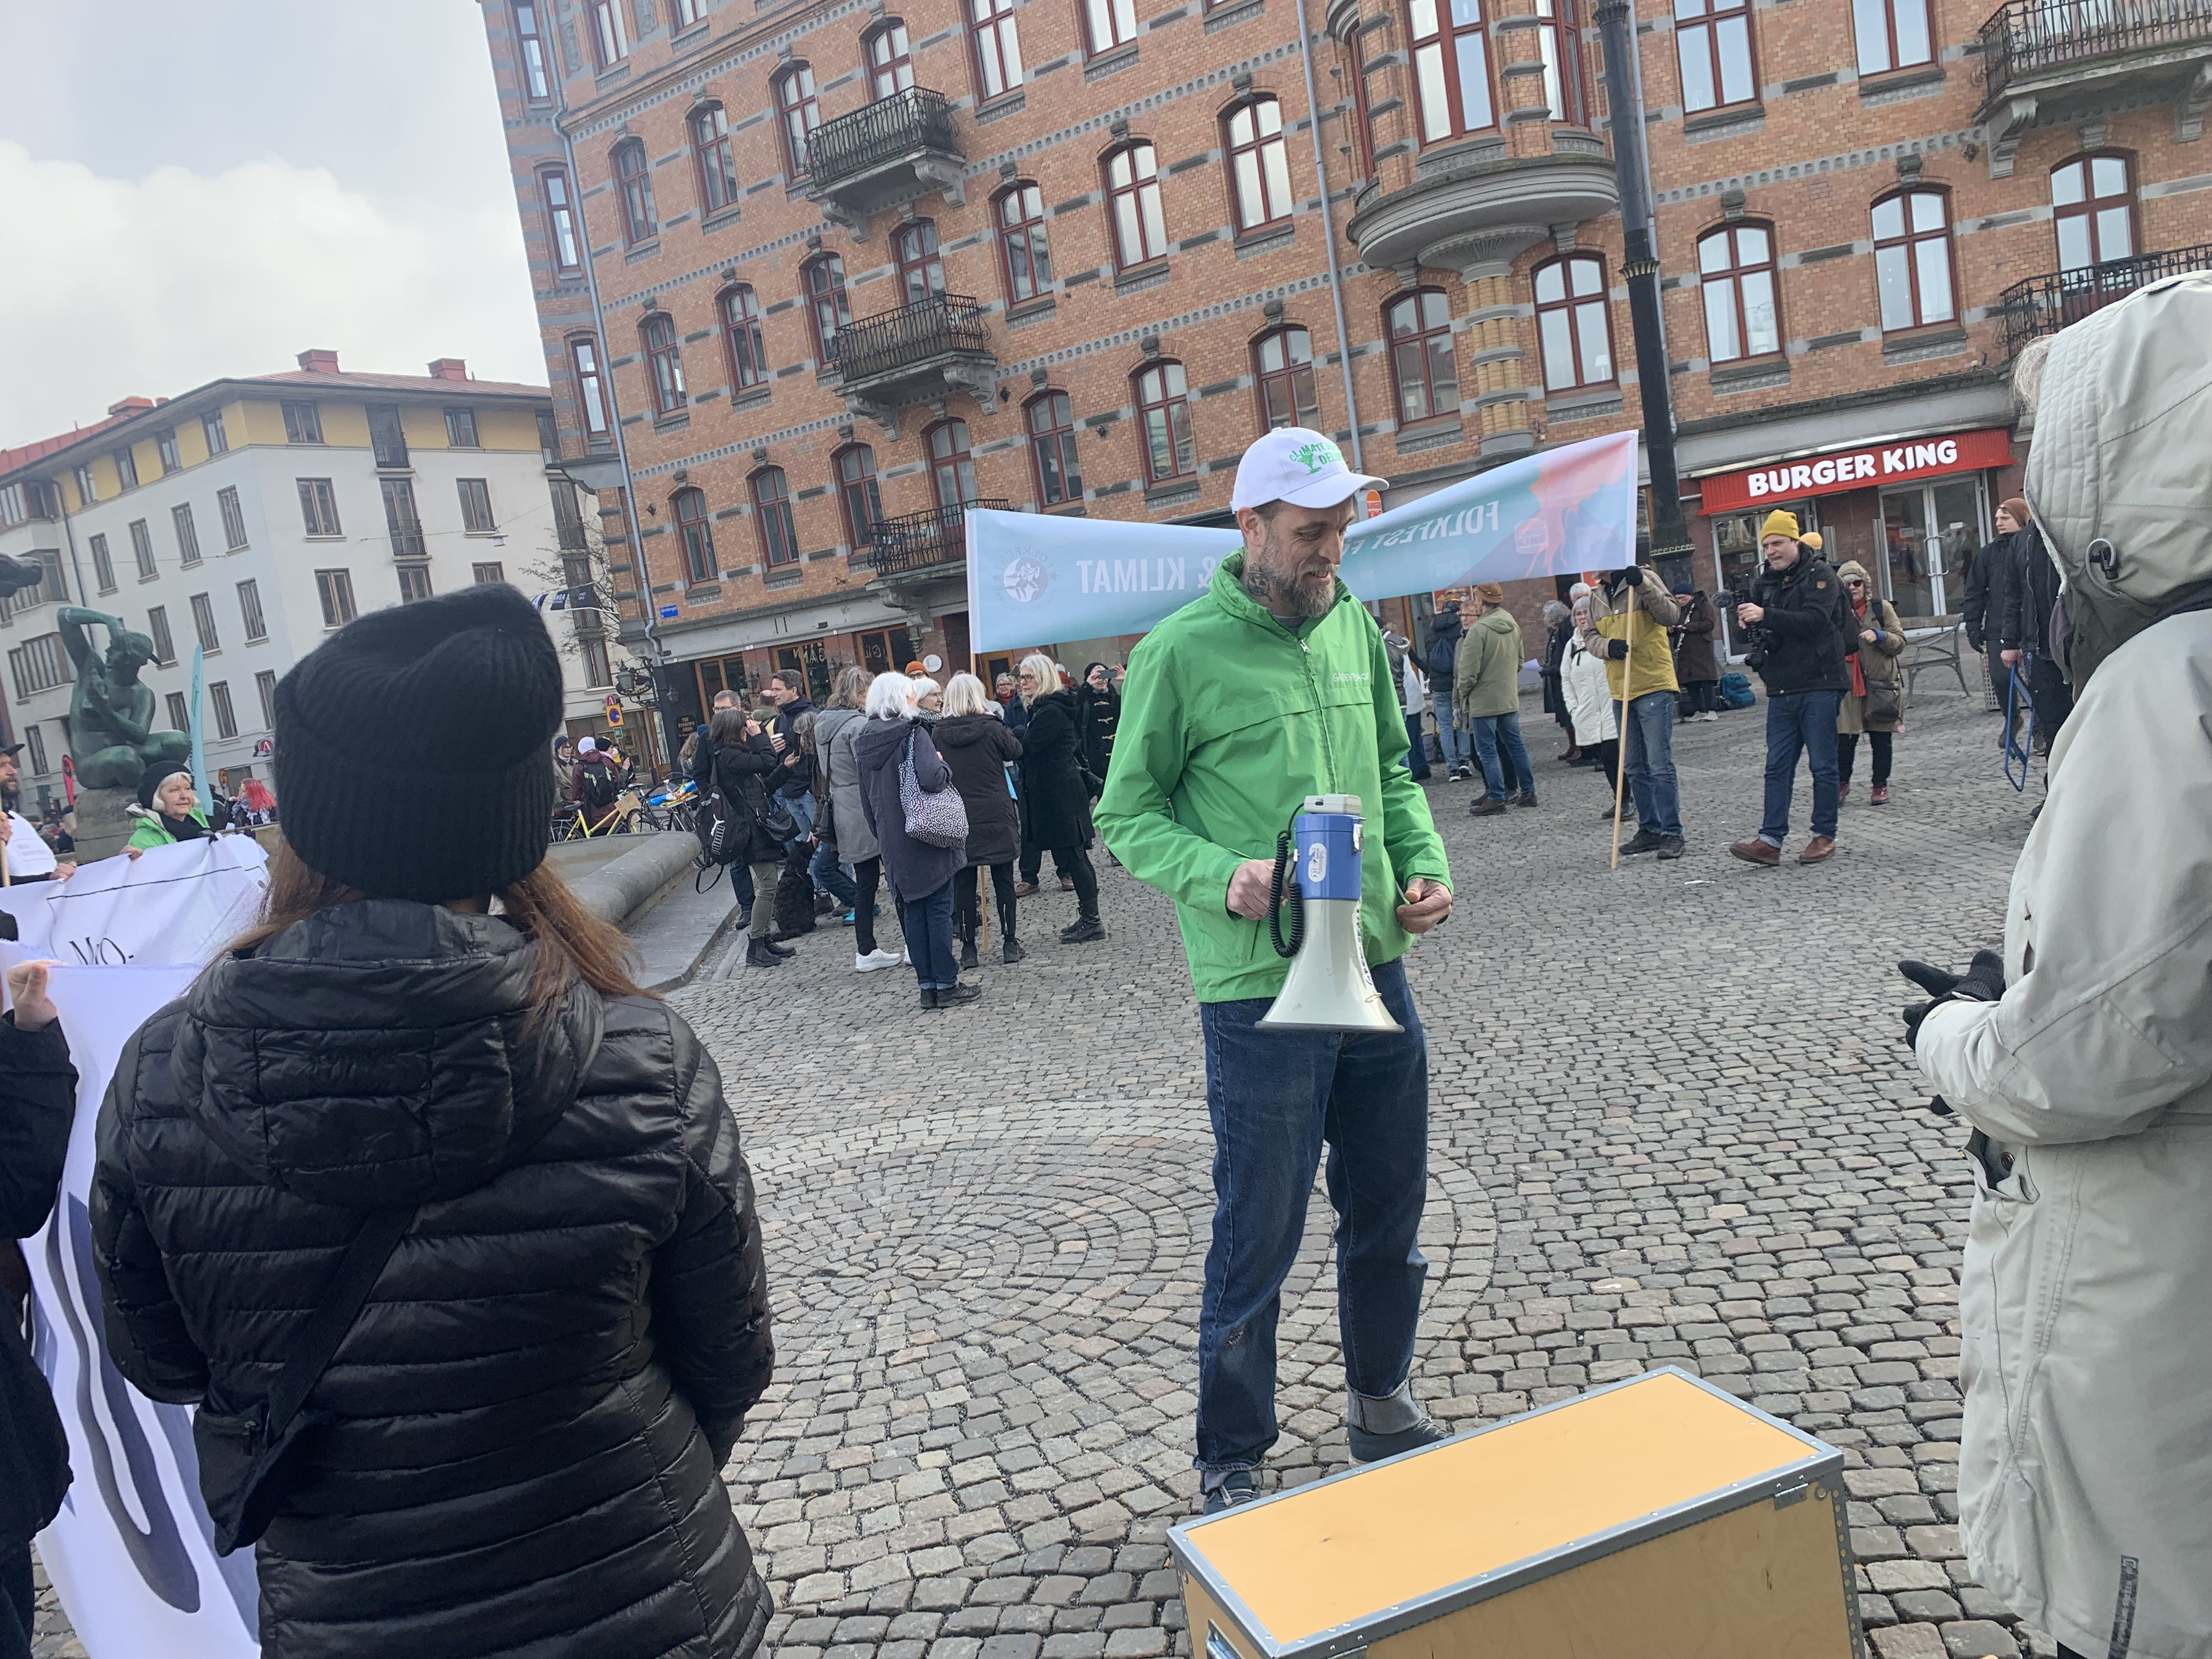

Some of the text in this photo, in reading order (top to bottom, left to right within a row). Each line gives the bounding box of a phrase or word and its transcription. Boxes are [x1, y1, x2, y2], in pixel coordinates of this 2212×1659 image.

[1289, 442, 1327, 462] CLIMATE
[1748, 440, 1958, 497] BURGER KING
[1332, 673, 1369, 682] GREENPEACE
